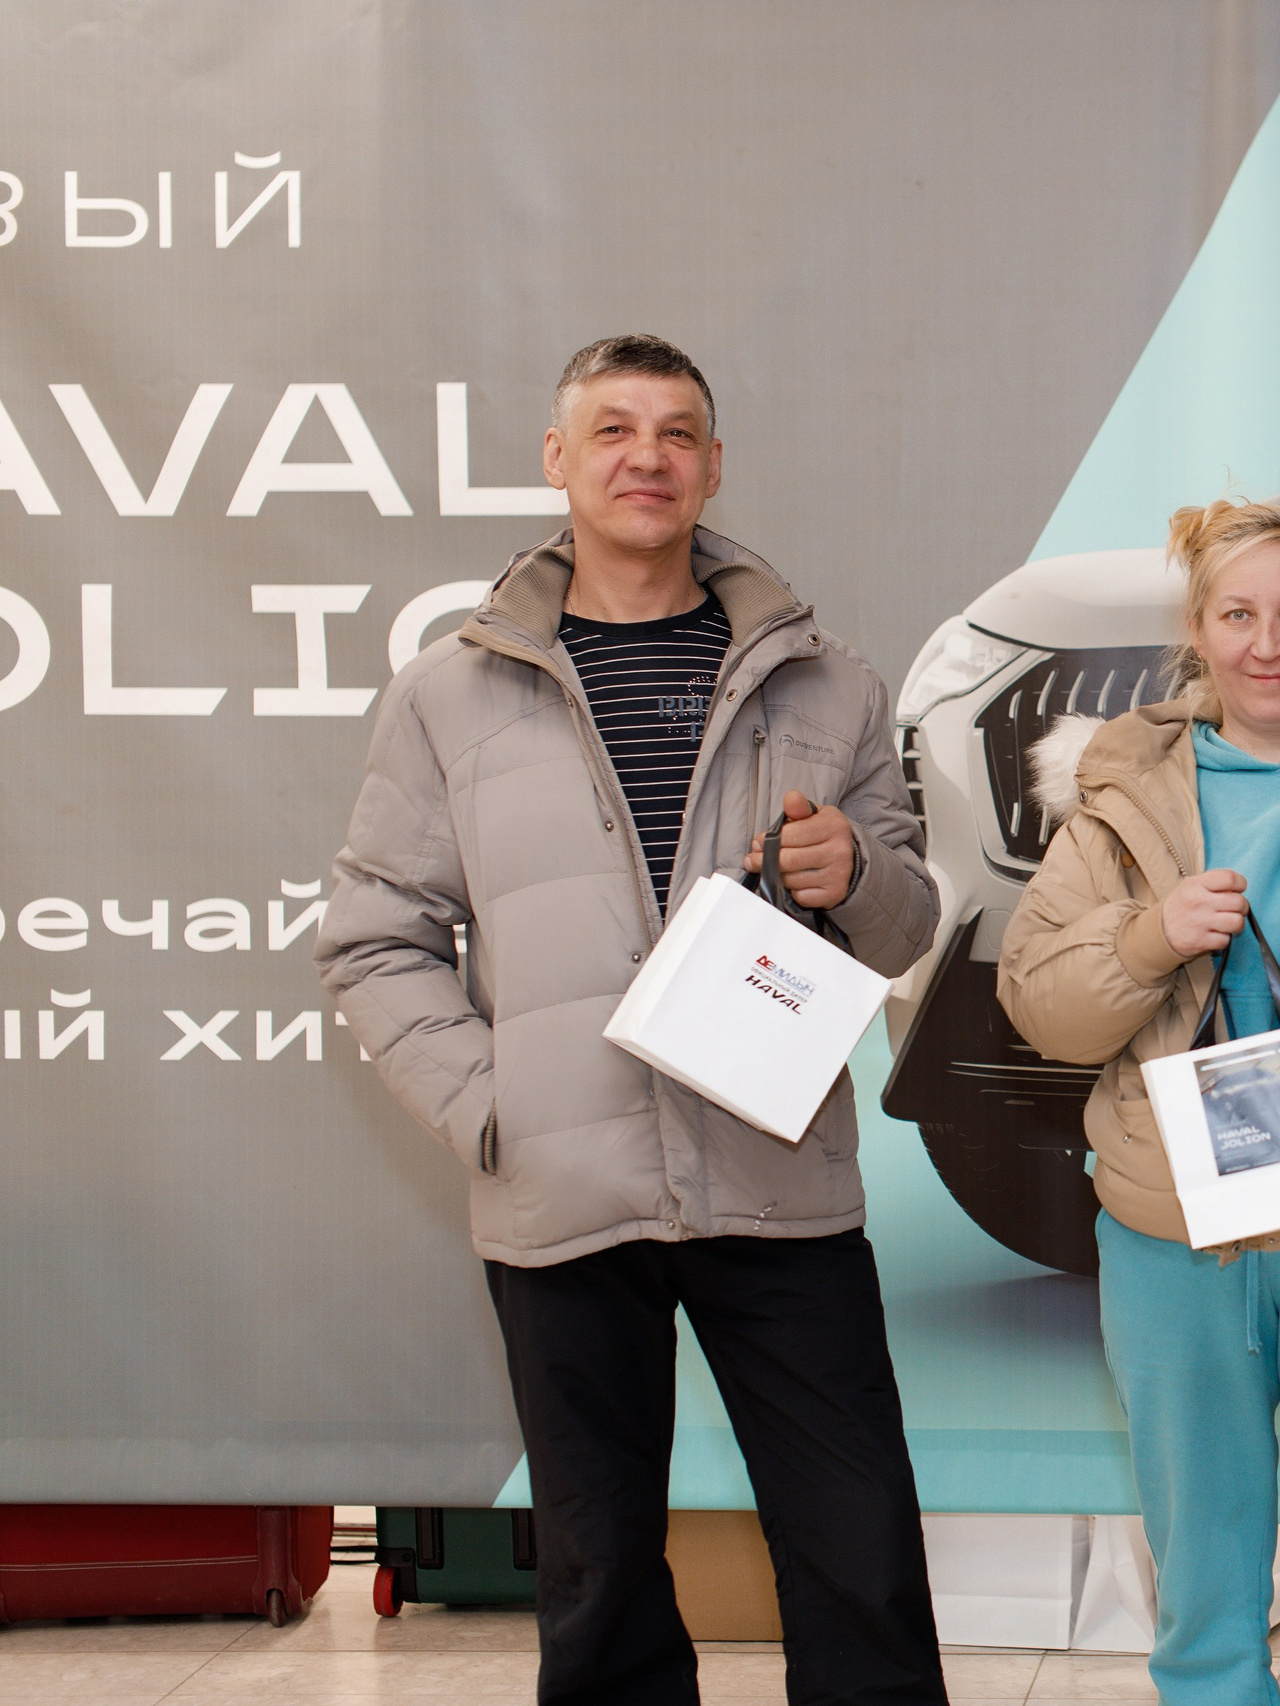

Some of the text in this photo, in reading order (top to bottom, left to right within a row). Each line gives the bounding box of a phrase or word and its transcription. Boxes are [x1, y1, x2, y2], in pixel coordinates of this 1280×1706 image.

[795, 740, 835, 755] OUTVENTURE
[745, 974, 802, 1015] HAVAL
[1217, 1124, 1260, 1141] HAVAL
[1220, 1131, 1272, 1151] JOLION
